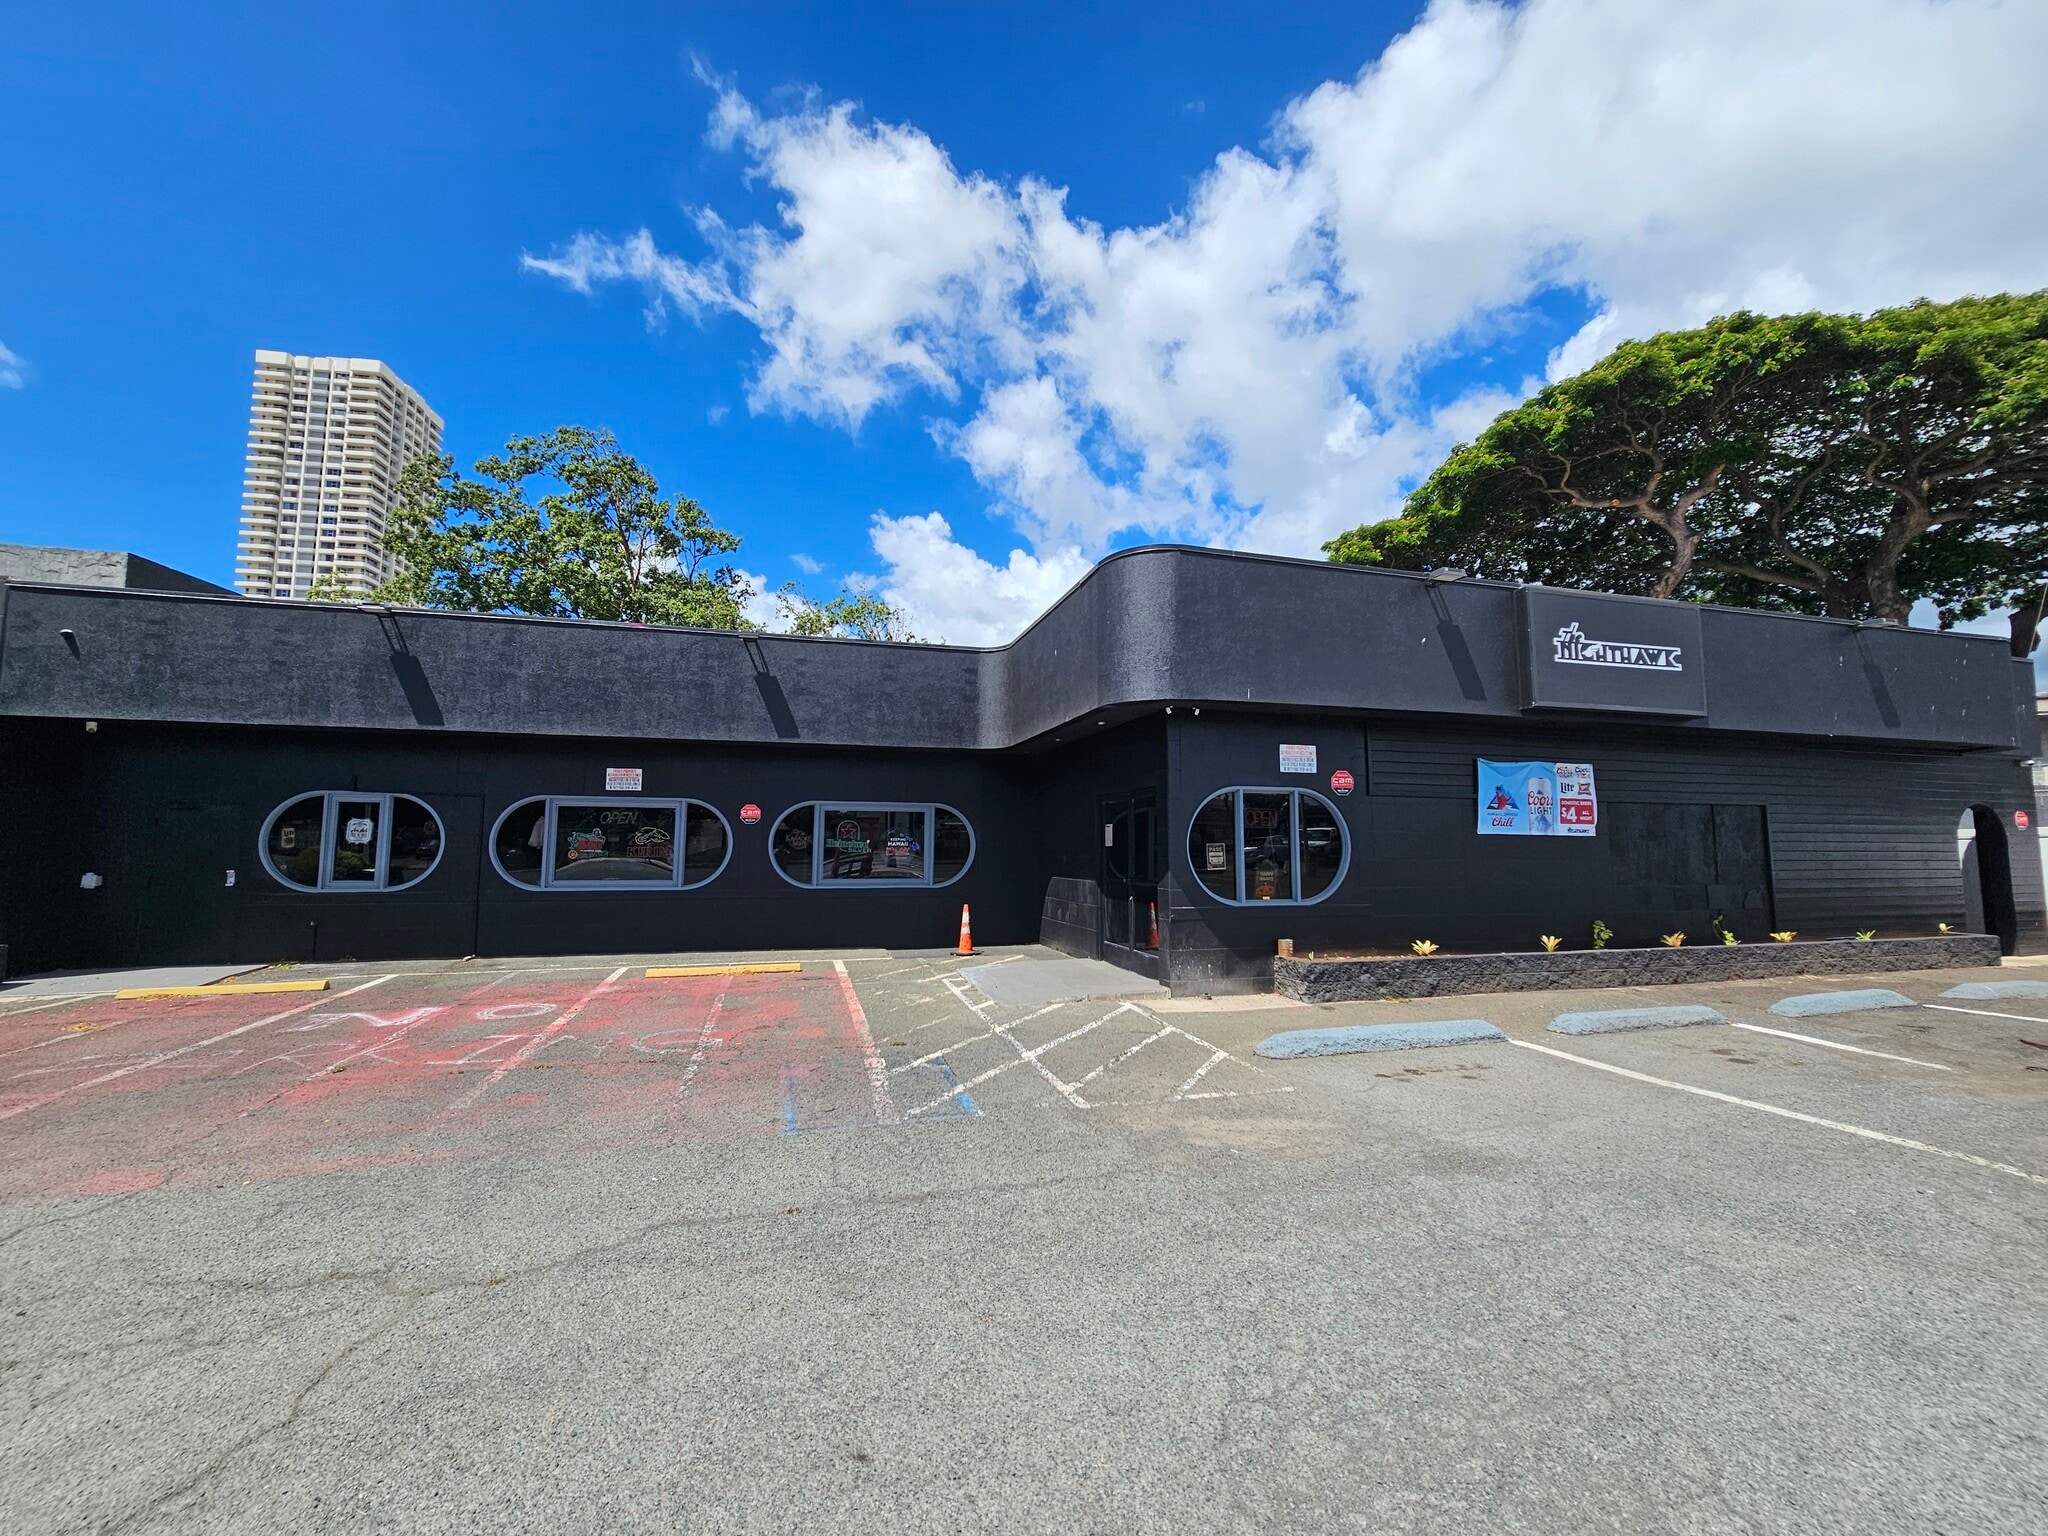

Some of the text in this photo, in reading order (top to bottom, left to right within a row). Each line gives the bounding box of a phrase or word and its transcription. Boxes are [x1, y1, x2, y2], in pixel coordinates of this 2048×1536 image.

[1560, 782, 1575, 794] Lite
[1528, 791, 1553, 806] Coors
[600, 811, 638, 825] OPEN
[1530, 807, 1552, 815] LIGHT
[1561, 807, 1578, 823] $4
[1246, 810, 1277, 827] OPEN
[1492, 817, 1514, 828] Chill
[278, 1002, 557, 1033] NO
